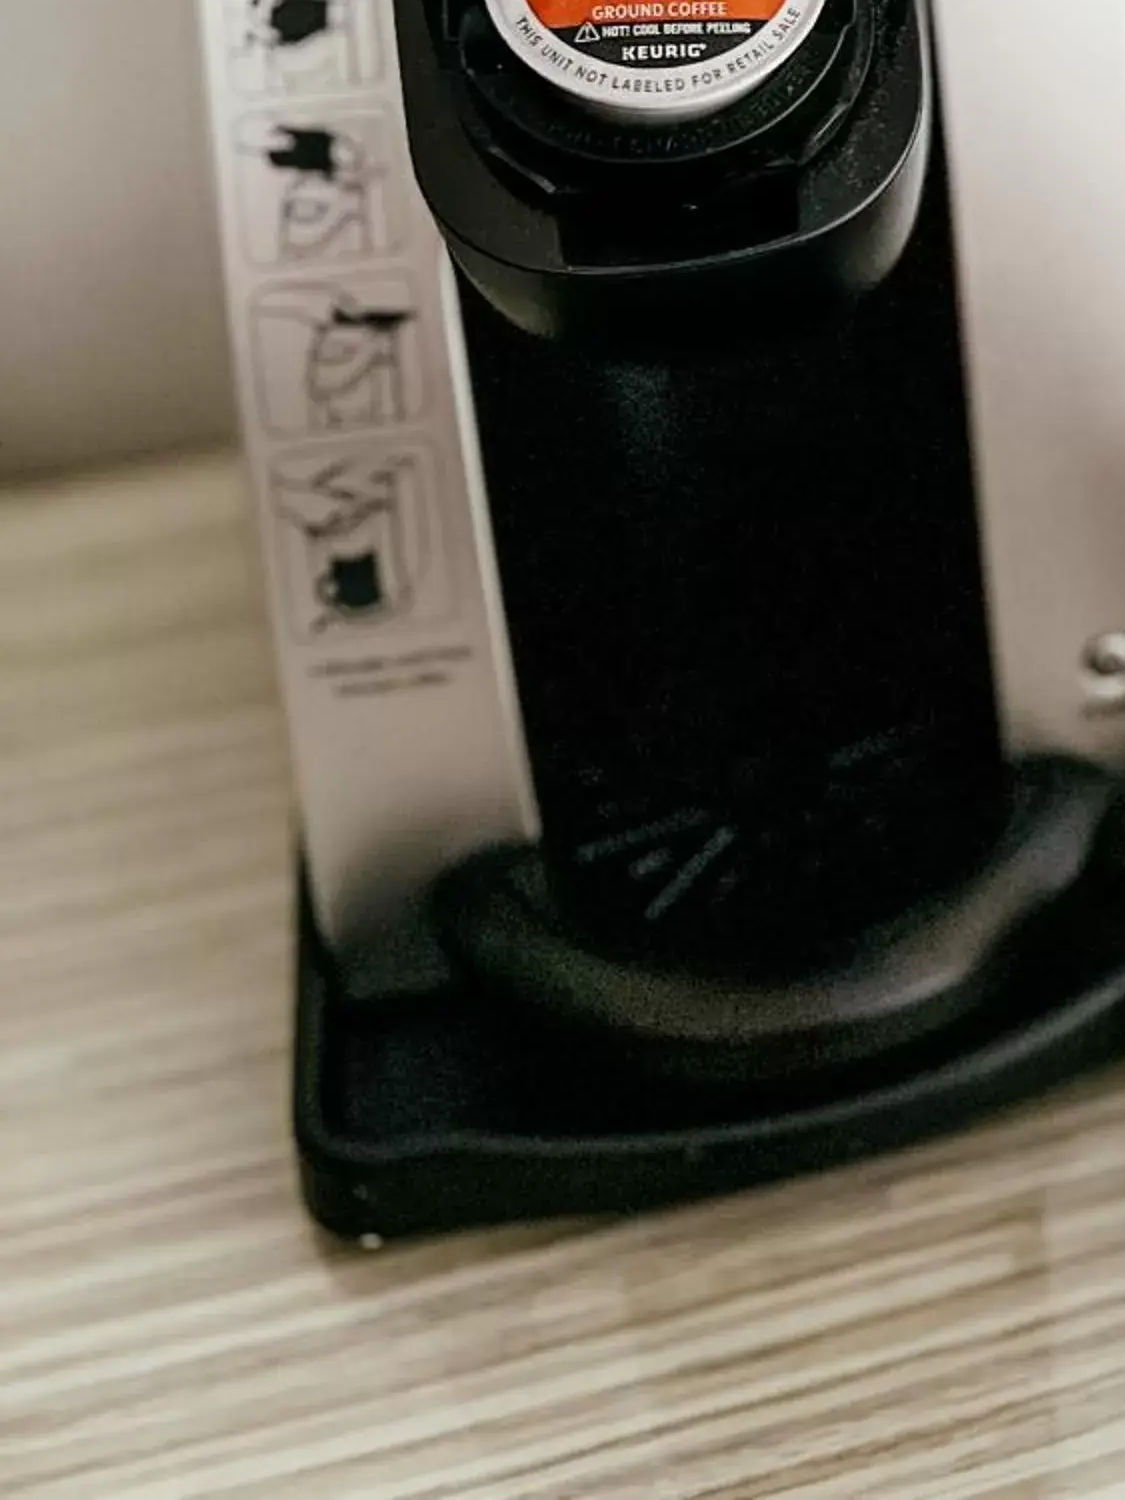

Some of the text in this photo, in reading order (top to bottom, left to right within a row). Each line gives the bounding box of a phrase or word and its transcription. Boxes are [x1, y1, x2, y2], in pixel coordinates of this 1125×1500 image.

[592, 2, 728, 19] GROUND COFFEE
[633, 24, 660, 36] COOL
[663, 22, 704, 35] BEFORE
[706, 22, 751, 33] PEELING
[516, 7, 800, 92] THIS UNIT NOT LABELED FOR RETAIL SALE
[622, 43, 707, 61] KEURIG
